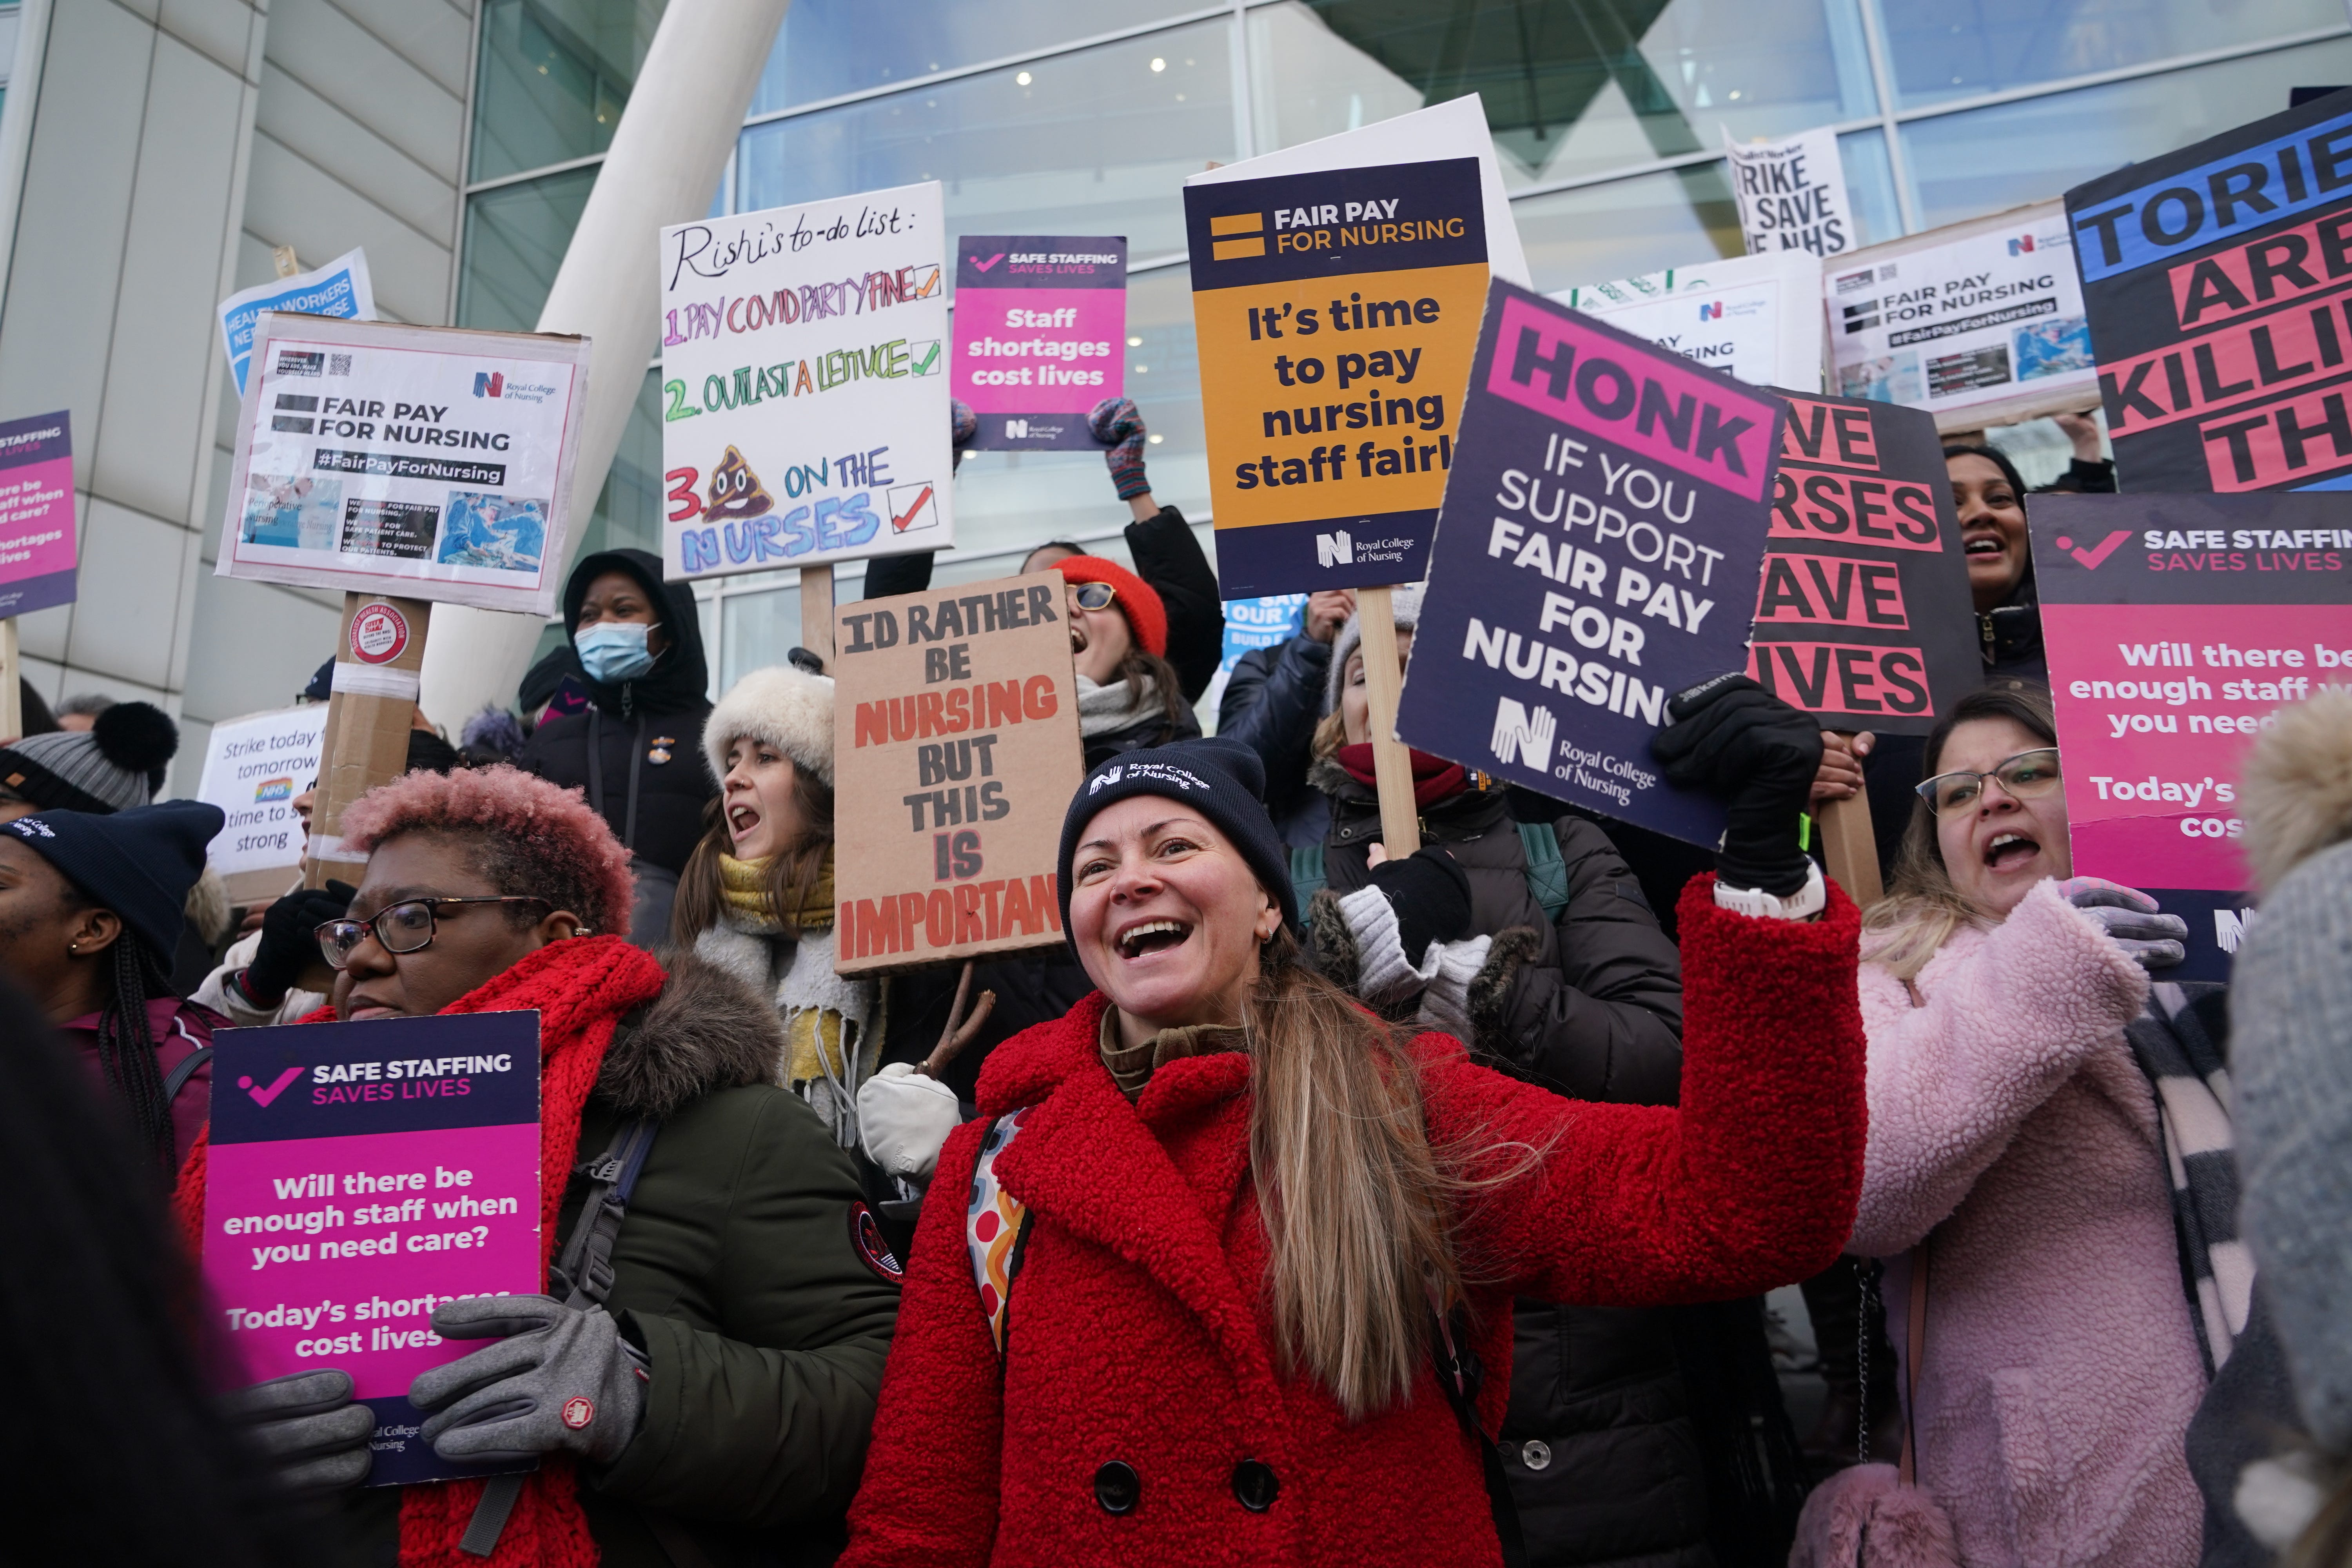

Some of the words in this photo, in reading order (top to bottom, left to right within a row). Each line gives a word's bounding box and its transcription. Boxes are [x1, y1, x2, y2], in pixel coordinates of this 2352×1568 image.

[1757, 184, 1834, 229] SAVE
[2076, 124, 2352, 268] TORIE
[1274, 205, 1339, 230] FAIR
[1345, 198, 1399, 222] PAY
[668, 221, 784, 292] Rishi's
[789, 212, 849, 252] to-do
[1277, 229, 1332, 254] FOR
[1341, 218, 1465, 247] NURSING
[1009, 254, 1047, 264] SAFE
[1048, 254, 1118, 265] STAFFING
[1009, 264, 1053, 274] SAVES
[1057, 264, 1095, 274] LIVES
[281, 278, 350, 312] WORKERS
[684, 296, 725, 340] PAY
[727, 288, 800, 334] COVID
[797, 271, 871, 323] PARTY
[867, 265, 916, 312] FINE
[1884, 286, 1937, 309] FAIR
[1945, 272, 1993, 294] PAY
[1885, 304, 1933, 324] FOR
[1941, 274, 2055, 312] NURSING
[1005, 308, 1078, 328] Staff
[1248, 302, 1319, 341] It's
[1329, 292, 1441, 332] time
[1890, 300, 2055, 346] #FairPayForNursing
[968, 337, 1111, 361] shortages
[2098, 297, 2352, 430] KILLI
[703, 361, 795, 413] OUTLAST
[794, 359, 813, 397] A
[817, 339, 909, 392] LETTUCE
[971, 368, 1033, 386] cost
[1038, 365, 1104, 386] lives
[1274, 355, 1325, 387] to
[1336, 347, 1422, 390] pay
[506, 383, 528, 393] Royal
[529, 383, 556, 395] College
[514, 392, 543, 404] Nursing
[1510, 325, 1757, 479] HONK
[322, 397, 385, 418] FAIR
[393, 403, 449, 423] PAY
[1263, 389, 1445, 438] nursing
[318, 419, 376, 440] FOR
[383, 424, 510, 451] NURSING
[2204, 393, 2352, 485] TH
[318, 453, 501, 484] #FairPayForNursing
[784, 457, 828, 498] ON
[833, 446, 895, 488] THE
[1236, 444, 1346, 490] staff
[1356, 434, 1455, 478] fairl
[1544, 433, 1588, 476] IF
[1599, 452, 1696, 524] YOU
[22, 488, 64, 505] when
[23, 481, 42, 492] be
[11, 504, 50, 522] care?
[1770, 470, 1938, 545] RSES
[681, 492, 881, 574] NURSES
[1495, 468, 1725, 586] SUPPORT
[2144, 530, 2228, 549] SAFE
[2232, 529, 2352, 550] STAFFIN
[1356, 541, 1380, 554] Royal
[1381, 537, 1414, 550] College
[1357, 553, 1367, 563] of
[1368, 550, 1403, 562] Nursing
[2148, 552, 2247, 571] SAVES
[2255, 552, 2342, 571] LIVES
[1488, 516, 1607, 598] FAIR
[1615, 566, 1715, 635] PAY
[1759, 558, 1905, 626] AVE
[908, 585, 1058, 646] RATHER
[1232, 604, 1282, 624] OUR
[1539, 591, 1645, 666] FOR
[1231, 632, 1272, 646] BUILD
[2118, 642, 2193, 667] Will
[2202, 643, 2305, 668] there
[2314, 643, 2352, 668] be
[925, 642, 971, 684] BE
[1462, 617, 1665, 727] NURSIN
[1755, 646, 1929, 714] IVES
[2069, 676, 2212, 705] enough
[2223, 677, 2309, 701] staff
[855, 674, 1058, 749] NURSING
[2108, 713, 2177, 738] you
[224, 737, 265, 759] Strike
[270, 730, 316, 750] today
[917, 734, 998, 788] BUT
[238, 755, 319, 780] tomorrow
[1126, 770, 1140, 779] of
[1142, 769, 1190, 789] Nursing
[1166, 765, 1210, 790] College
[1559, 739, 1601, 769] Royal
[1602, 754, 1657, 790] College
[261, 784, 286, 798] NHS
[1555, 763, 1572, 780] of
[1573, 767, 1631, 807] Nursing
[2089, 776, 2235, 808] Today's
[228, 810, 263, 828] time
[270, 807, 285, 820] to
[903, 781, 1011, 832] THIS
[236, 831, 289, 852] strong
[933, 829, 984, 883] IS
[840, 873, 1063, 961] IMPORTAN
[312, 1063, 381, 1083] SAFE
[386, 1054, 512, 1079] STAFFING
[312, 1083, 395, 1105] SAVES
[403, 1078, 471, 1098] LIVES
[273, 1173, 335, 1200] Will
[343, 1172, 427, 1195] there
[435, 1166, 474, 1189] be
[223, 1205, 345, 1236] enough
[352, 1198, 426, 1226] staff
[432, 1195, 518, 1219] when
[251, 1243, 310, 1271] you
[320, 1232, 398, 1259] need
[407, 1226, 490, 1252] care?
[226, 1300, 347, 1330] Today's
[296, 1332, 362, 1357] cost
[371, 1325, 444, 1351] lives
[368, 1439, 405, 1452] Nursing
[383, 1425, 420, 1437] College
